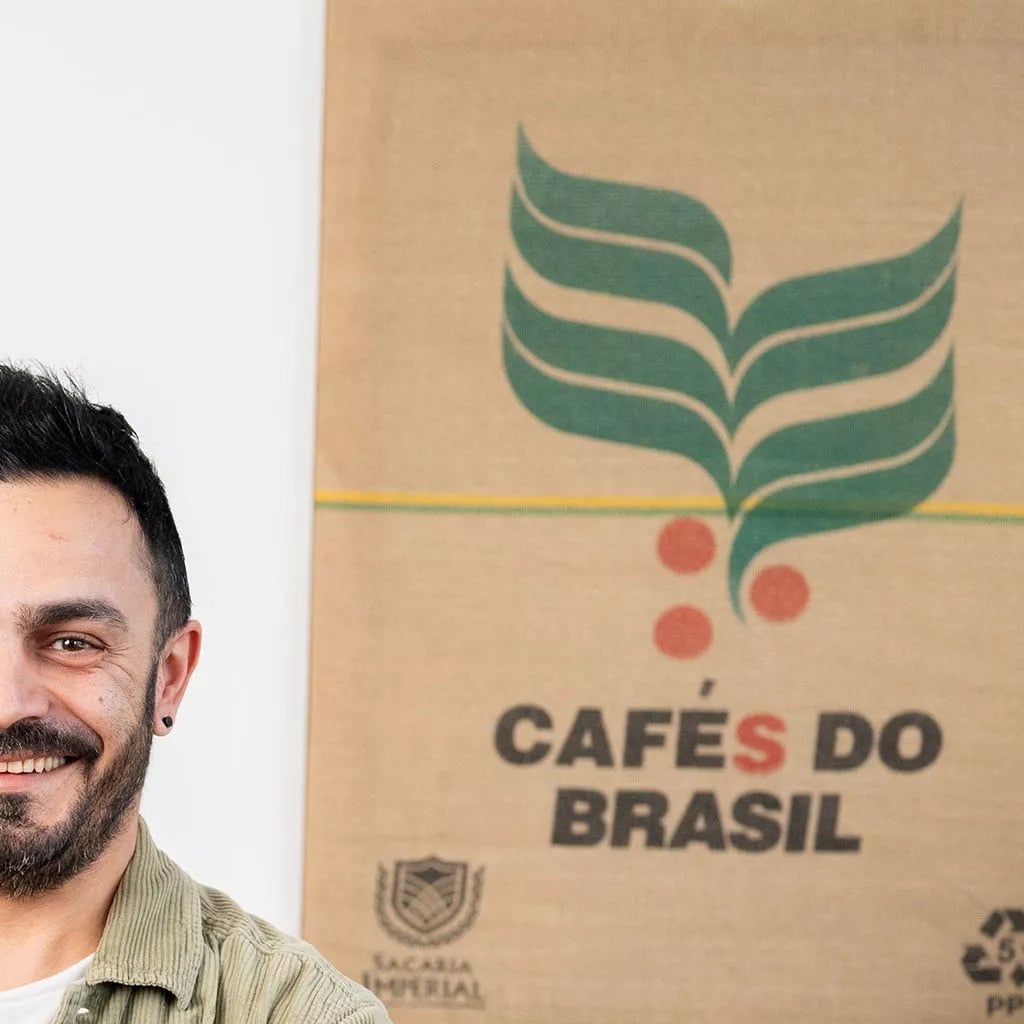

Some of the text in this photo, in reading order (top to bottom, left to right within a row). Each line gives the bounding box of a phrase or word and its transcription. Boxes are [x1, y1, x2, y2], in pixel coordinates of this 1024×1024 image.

[493, 678, 944, 776] CAFÉS DO
[550, 787, 862, 854] BRASIL
